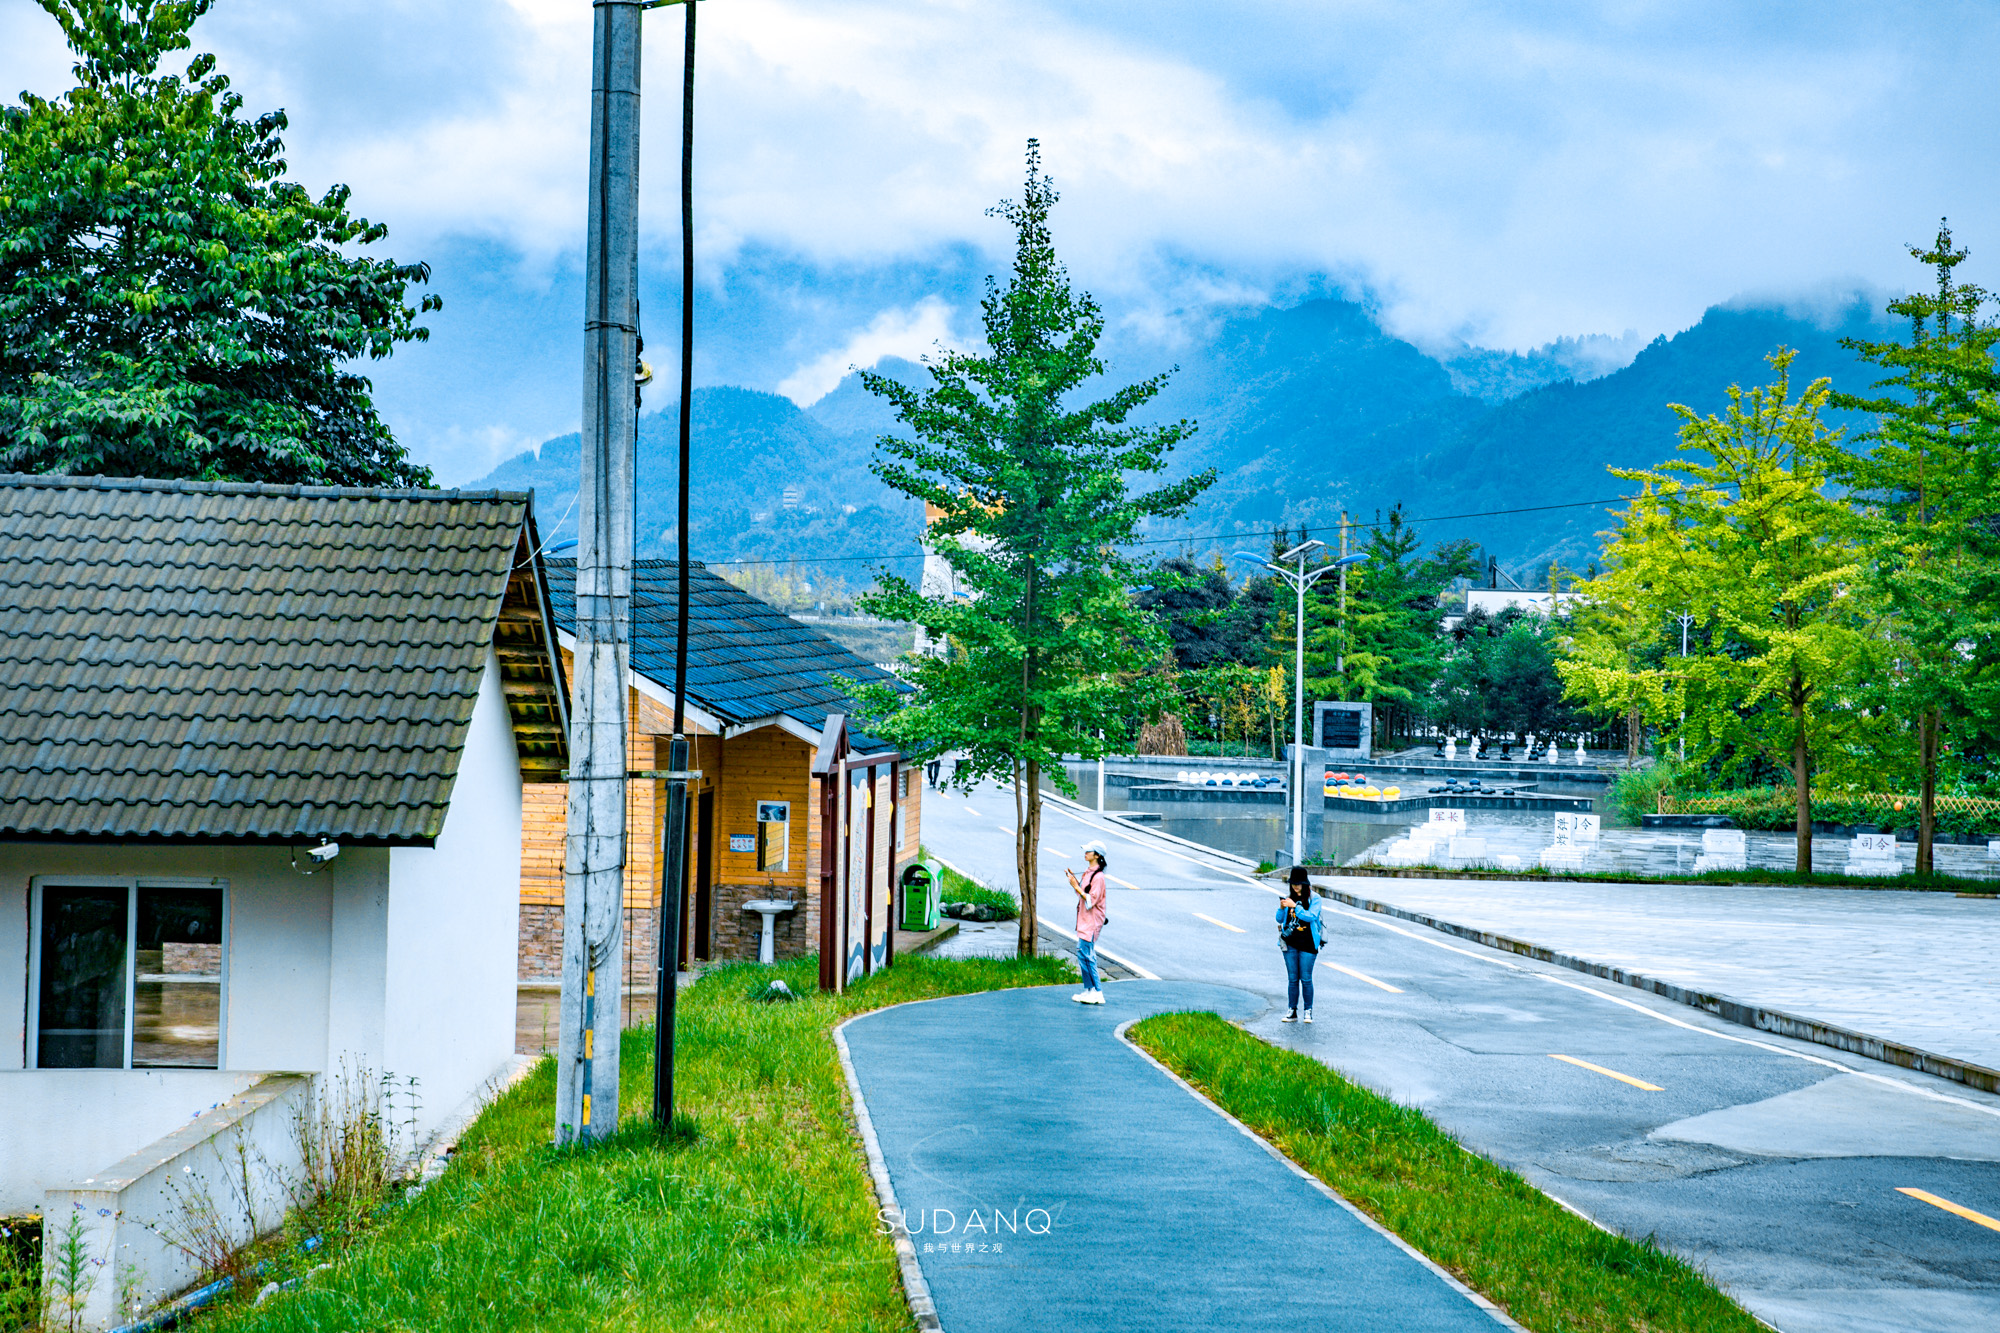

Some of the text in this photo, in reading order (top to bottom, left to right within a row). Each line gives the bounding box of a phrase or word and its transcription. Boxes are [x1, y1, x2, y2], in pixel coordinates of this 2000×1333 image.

[1434, 812, 1458, 822] 军长
[1556, 817, 1569, 846] 炸弹
[1862, 837, 1889, 850] 司令
